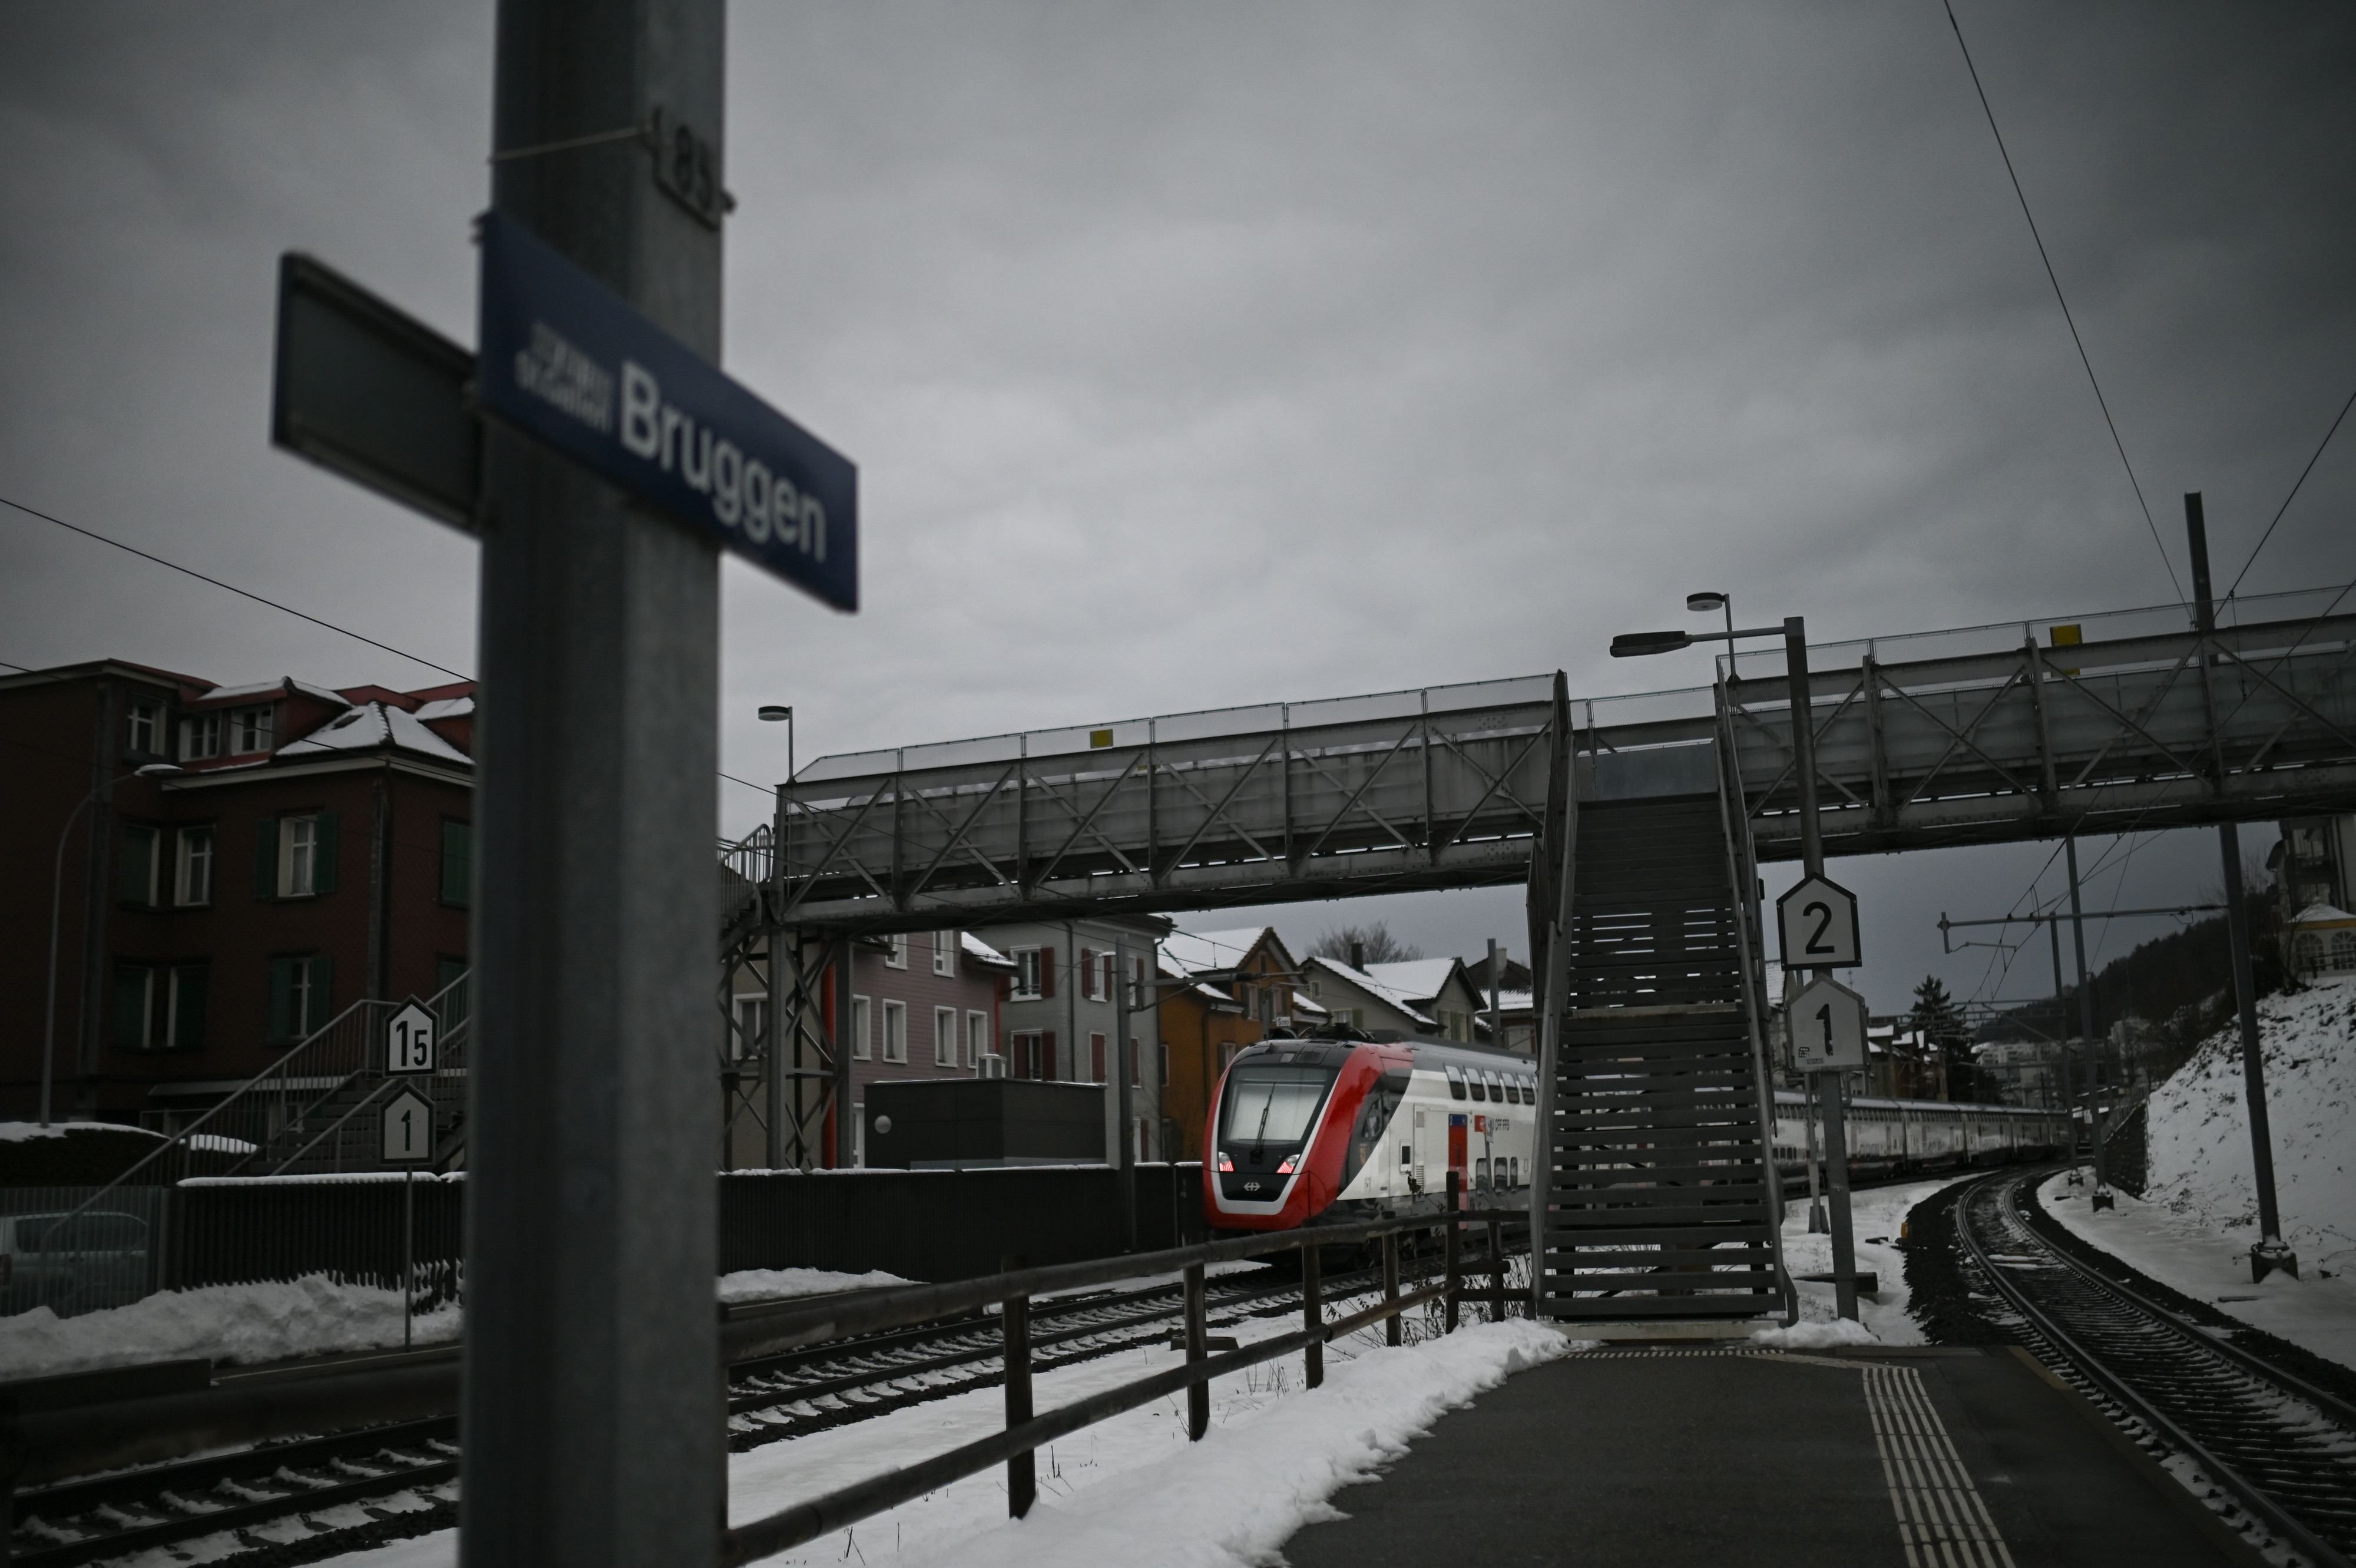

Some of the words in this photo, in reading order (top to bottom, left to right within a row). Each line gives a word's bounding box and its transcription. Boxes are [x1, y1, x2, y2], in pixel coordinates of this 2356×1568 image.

[620, 359, 827, 564] Bruggen
[1803, 901, 1835, 954] 2
[396, 1021, 427, 1066] 15
[1816, 1003, 1833, 1056] 1
[401, 1110, 411, 1151] 1
